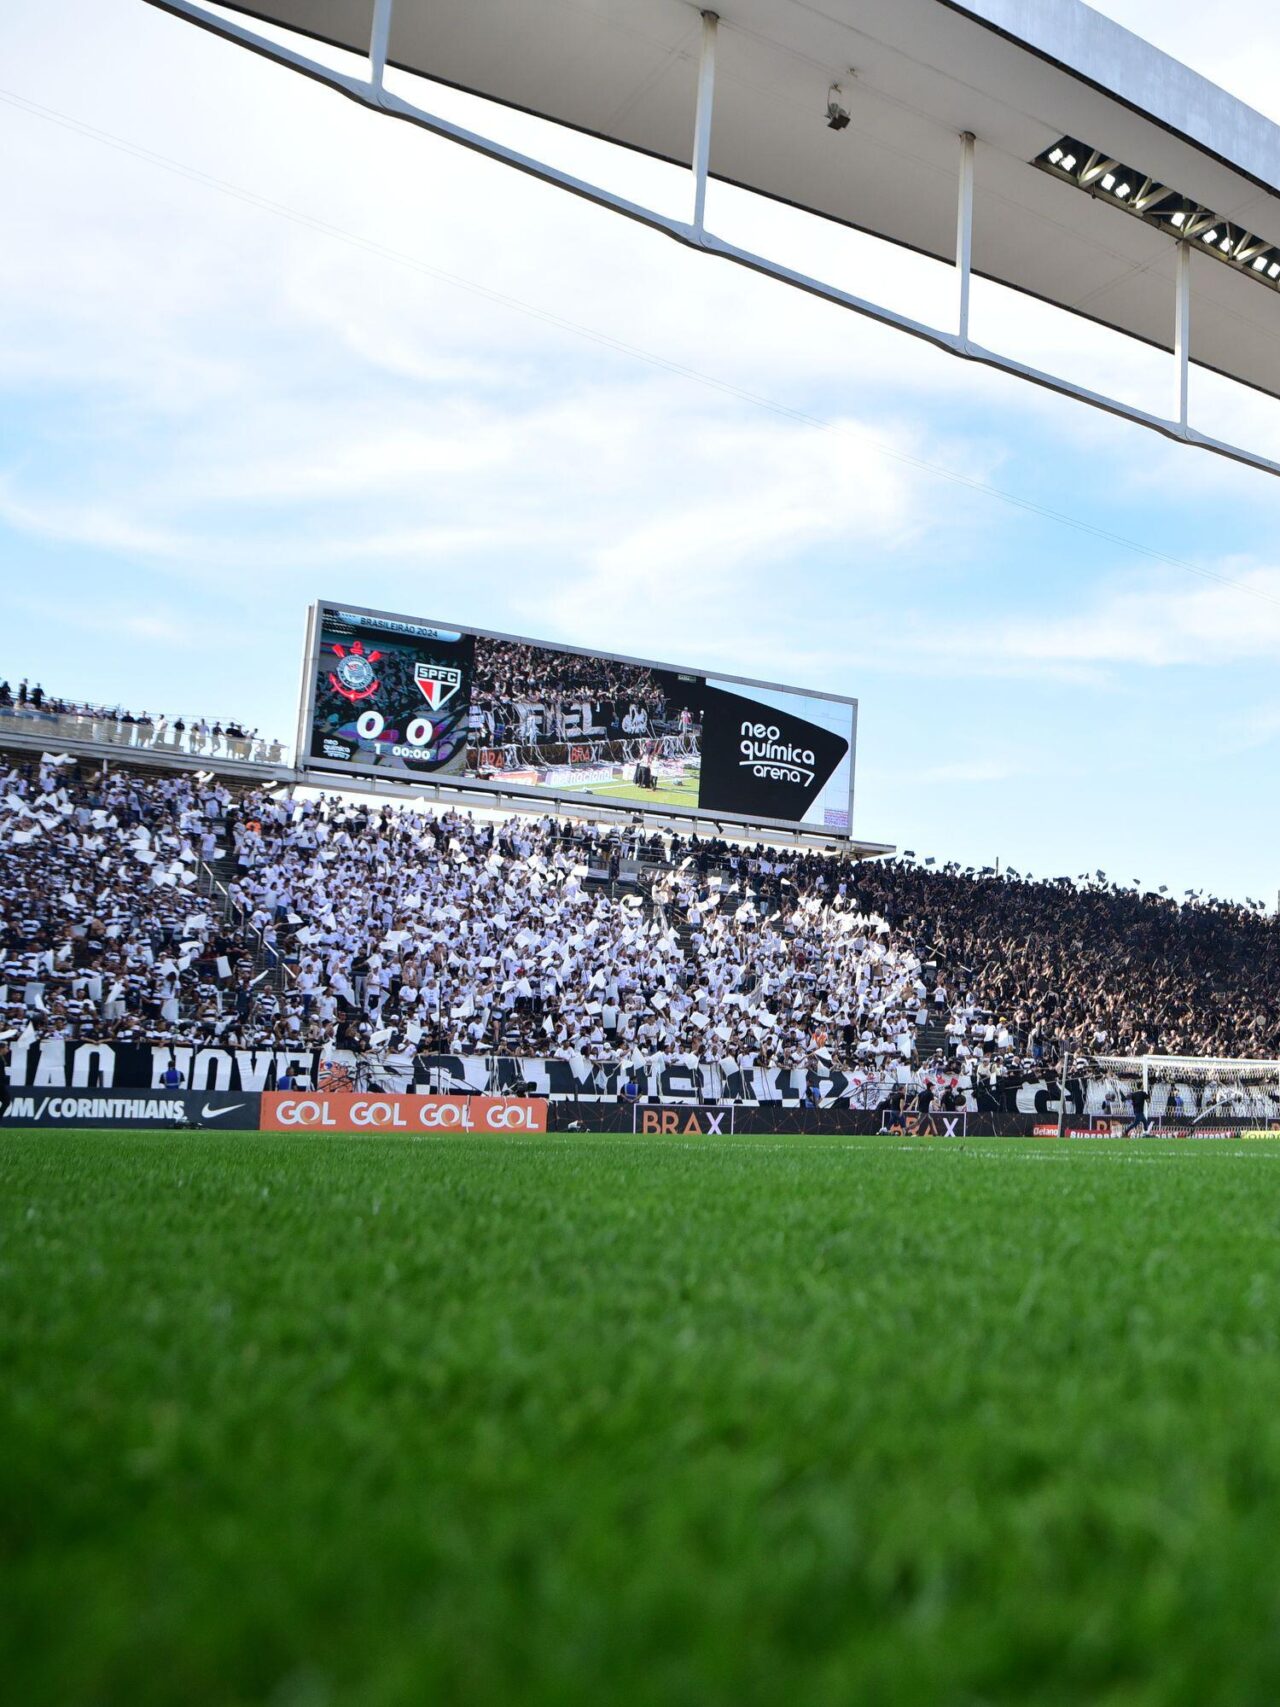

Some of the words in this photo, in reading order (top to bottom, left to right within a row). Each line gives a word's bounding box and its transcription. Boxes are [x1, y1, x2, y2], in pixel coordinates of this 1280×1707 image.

[360, 616, 416, 634] BRASILEIRÃO
[416, 627, 439, 638] 2024
[419, 667, 457, 683] SPFC
[356, 710, 385, 740] 0
[406, 718, 433, 747] 0
[741, 721, 780, 741] neo
[392, 746, 431, 760] 00:00
[740, 740, 815, 766] química
[753, 765, 801, 784] arena
[275, 1100, 337, 1126] GOL
[349, 1100, 407, 1127] GOL
[419, 1102, 475, 1128] GOL
[486, 1105, 539, 1129] GOL
[642, 1110, 725, 1135] BRAX
